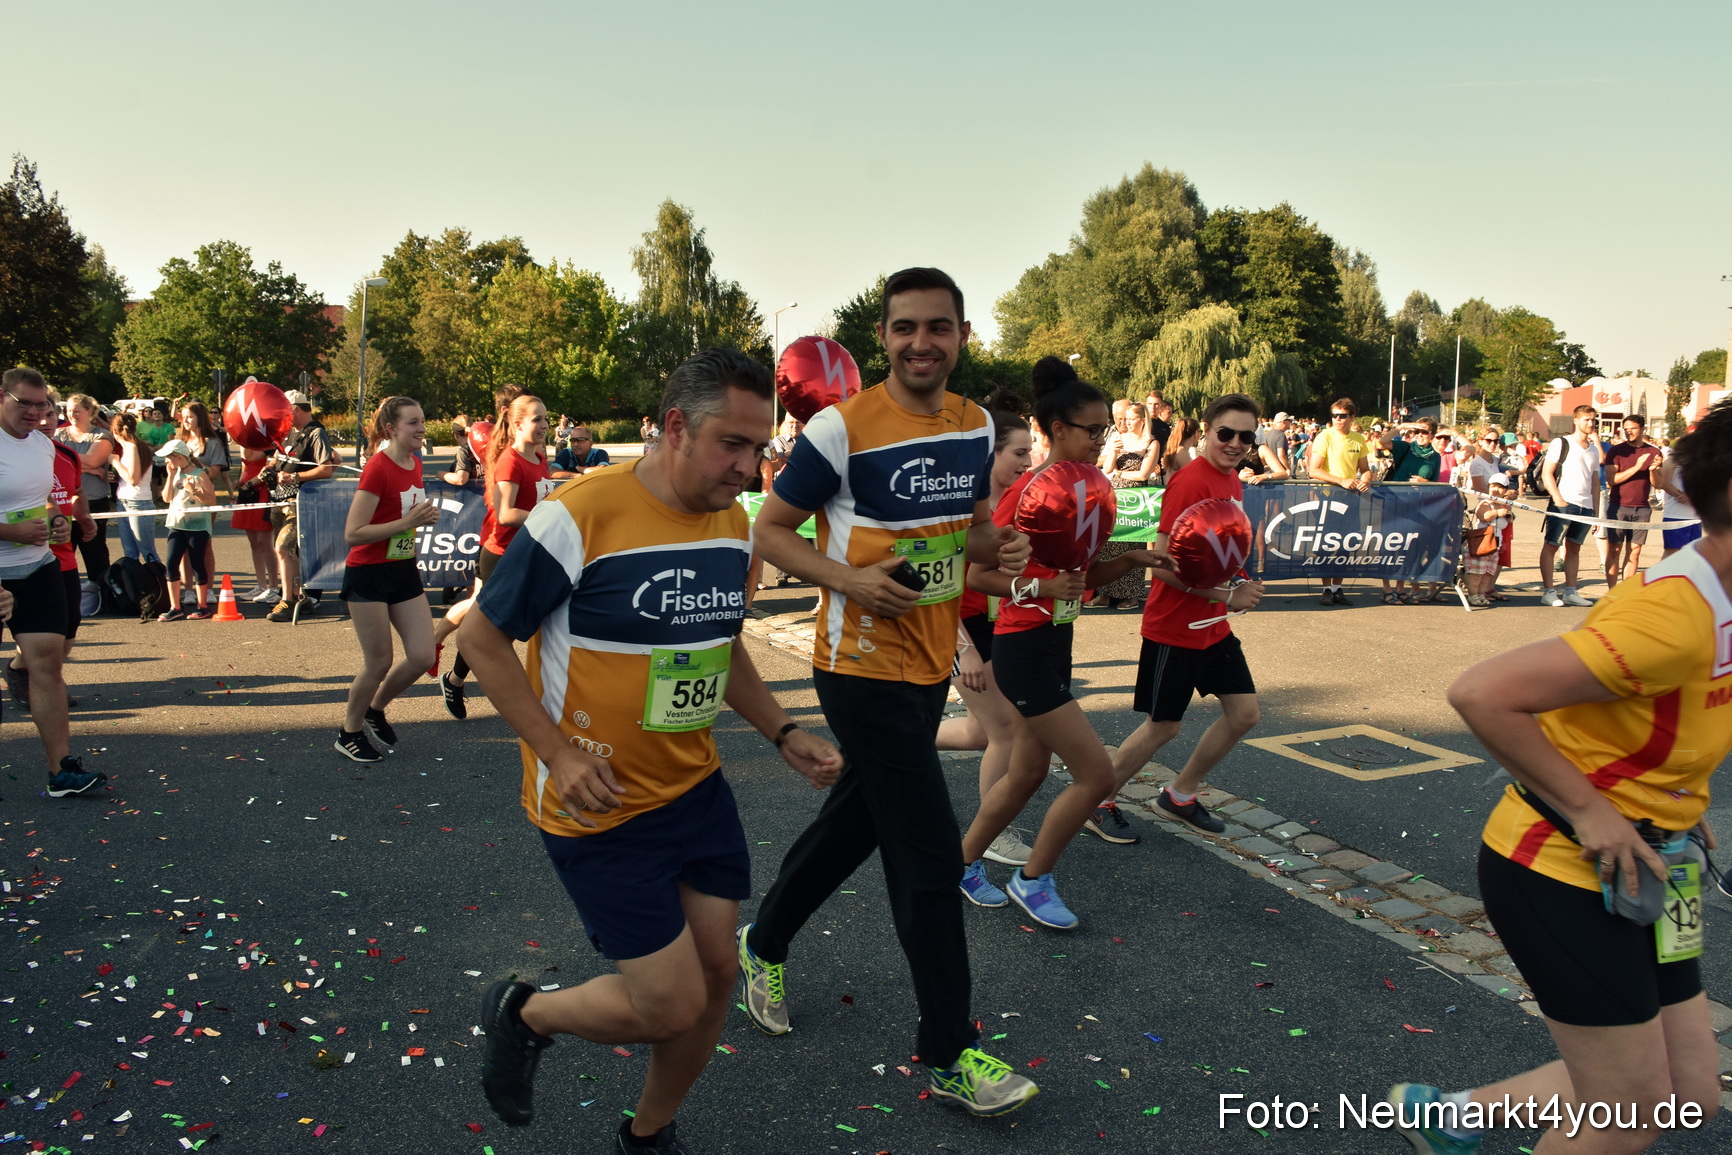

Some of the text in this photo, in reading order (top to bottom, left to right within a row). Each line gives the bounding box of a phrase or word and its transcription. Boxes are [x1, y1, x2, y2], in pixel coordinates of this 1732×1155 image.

[910, 472, 975, 494] Fischer
[396, 538, 414, 550] 425
[1293, 526, 1419, 552] Fischer
[918, 558, 954, 586] 581
[1302, 556, 1406, 566] AUTOMOBILE
[660, 586, 744, 612] Fischer
[670, 610, 744, 625] AUTOMOBILE
[672, 676, 718, 708] 584
